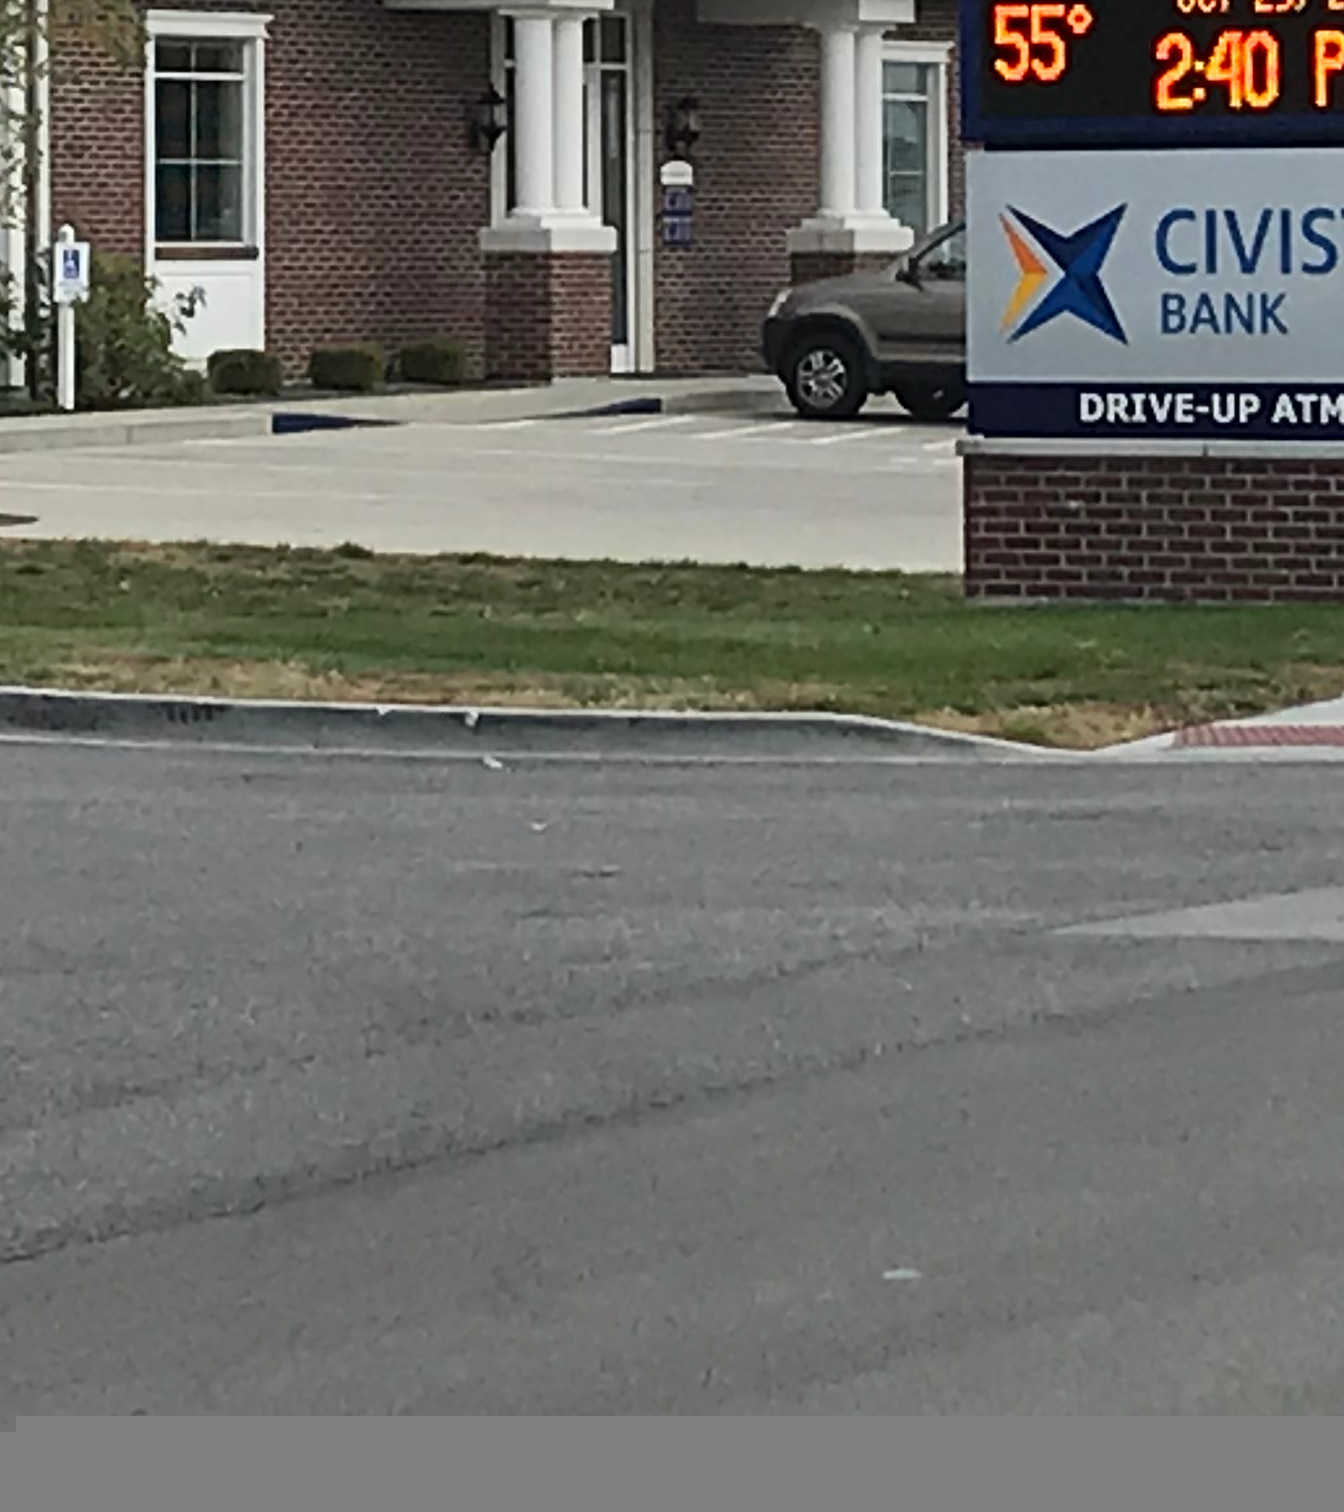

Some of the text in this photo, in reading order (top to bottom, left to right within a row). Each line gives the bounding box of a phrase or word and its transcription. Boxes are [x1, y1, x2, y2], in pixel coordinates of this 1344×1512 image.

[993, 2, 1094, 81] 55°
[1155, 31, 1279, 110] 2:40
[1161, 293, 1288, 335] BANK
[1079, 392, 1261, 424] DRIVE-UP
